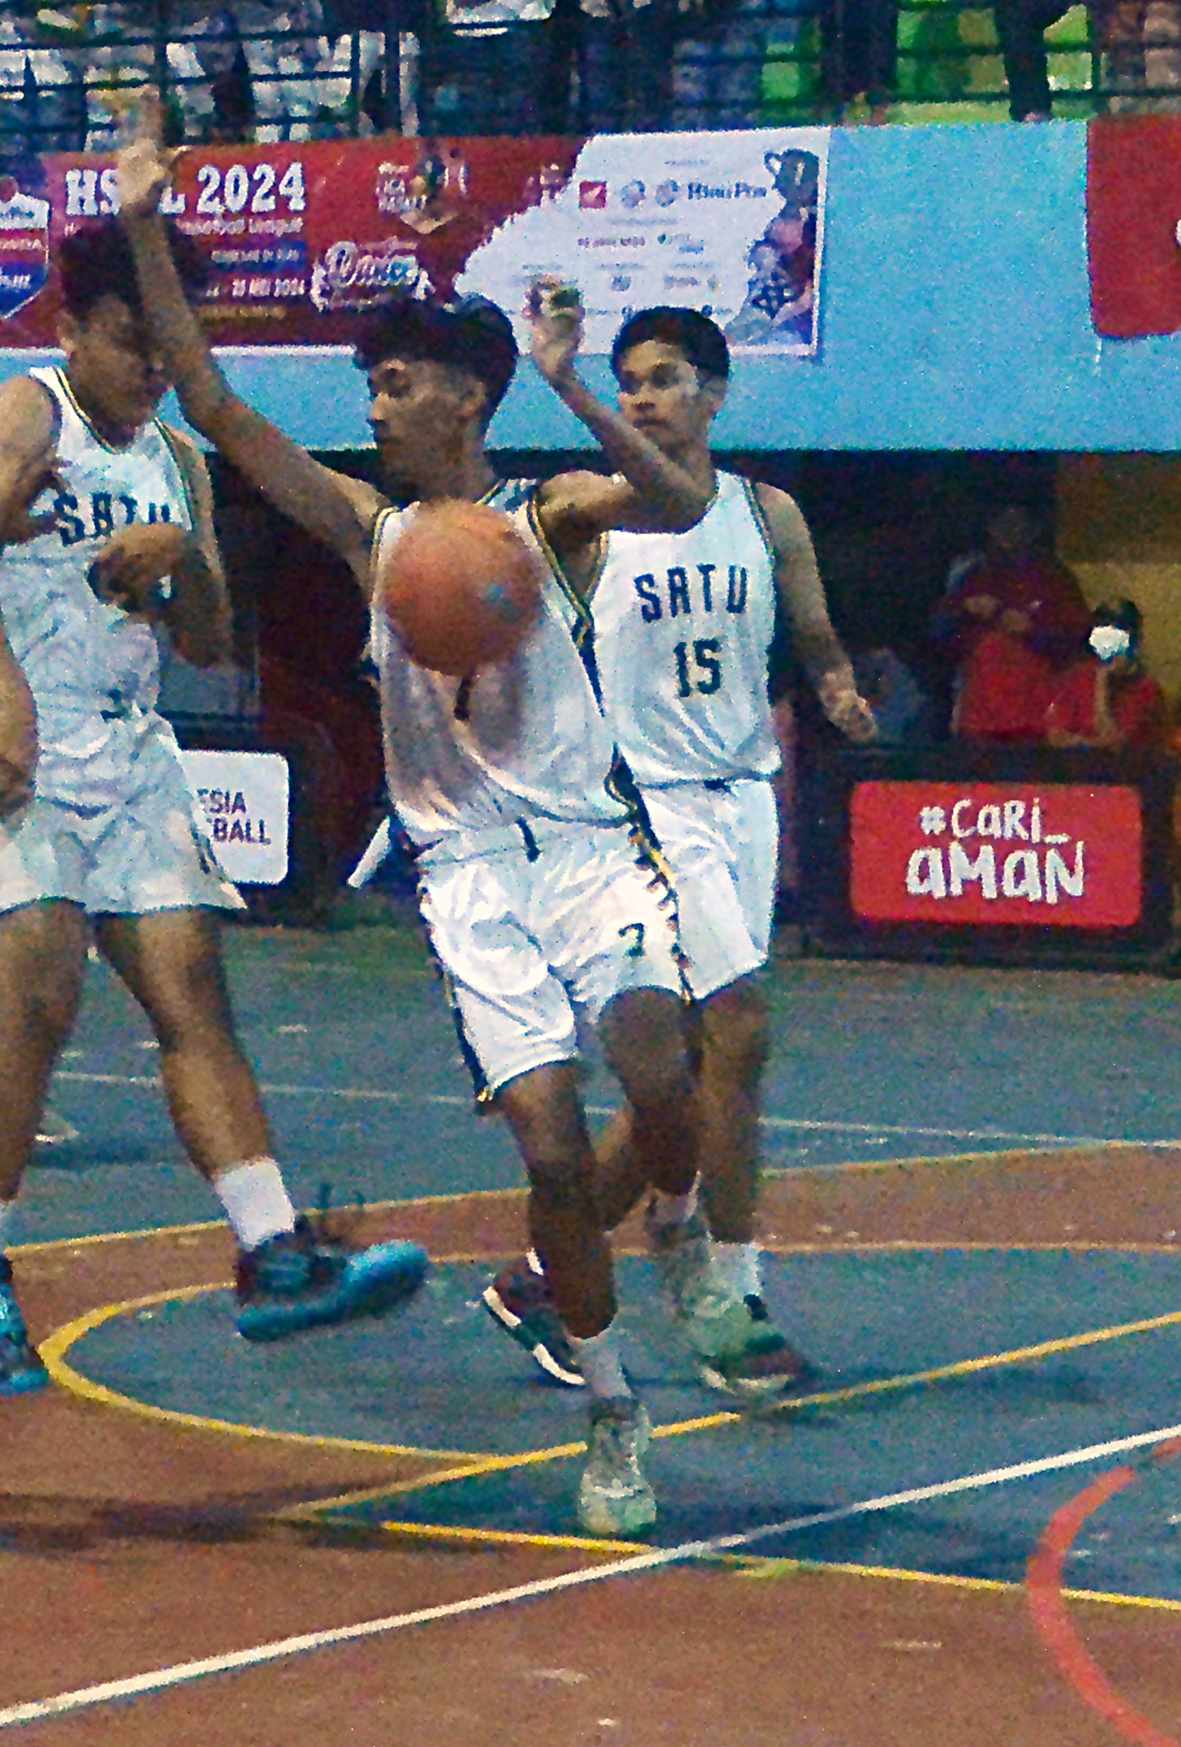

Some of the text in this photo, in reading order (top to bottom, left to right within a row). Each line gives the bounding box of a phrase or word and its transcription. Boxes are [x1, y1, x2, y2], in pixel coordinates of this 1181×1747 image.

[66, 161, 306, 215] HSL 2024
[53, 491, 170, 547] SATU
[634, 564, 748, 623] SATU
[673, 638, 722, 699] 15
[206, 817, 271, 845] BALL
